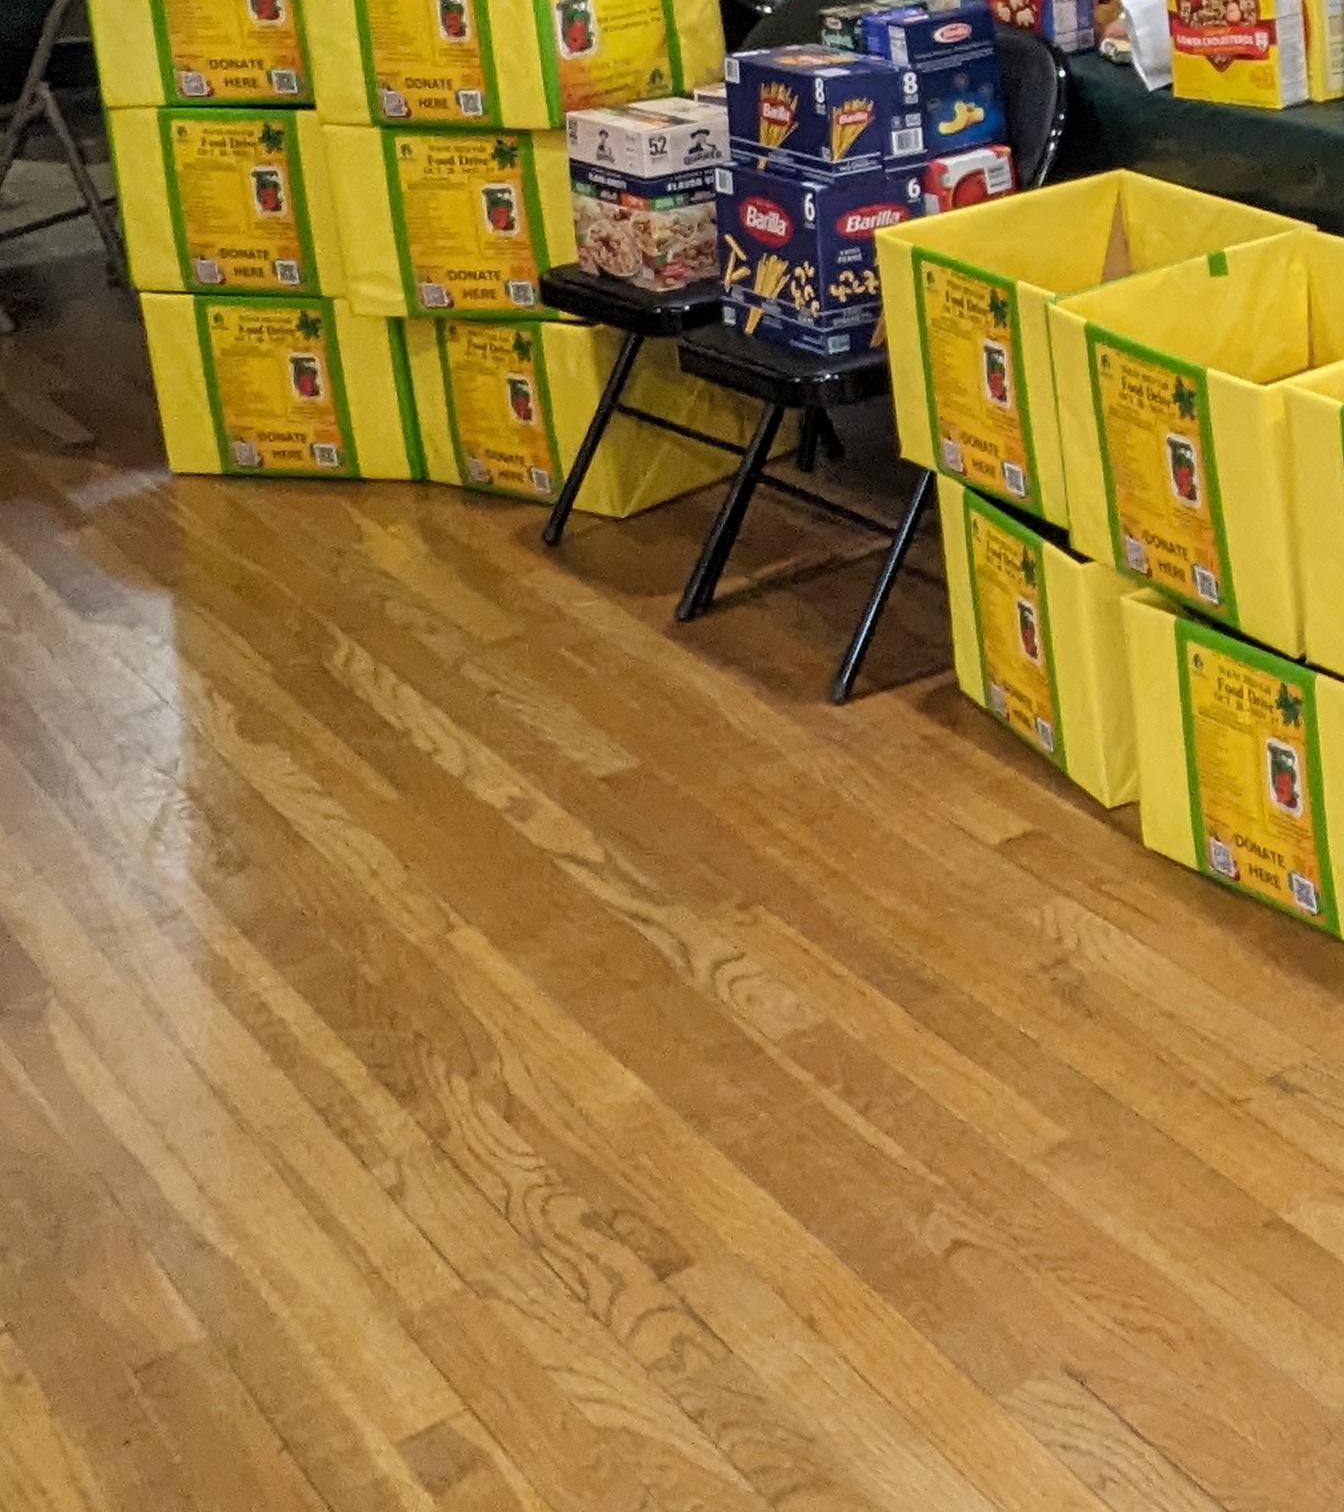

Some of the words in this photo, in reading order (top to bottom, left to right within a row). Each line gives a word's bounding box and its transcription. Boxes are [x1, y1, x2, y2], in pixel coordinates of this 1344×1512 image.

[208, 58, 265, 71] DONATE
[224, 77, 259, 89] HERE
[405, 78, 453, 90] DONATE
[814, 77, 826, 104] 8
[903, 72, 918, 94] 8
[418, 97, 448, 109] HERE
[648, 135, 668, 156] 52
[907, 177, 921, 198] 6
[804, 192, 816, 222] 6
[745, 205, 789, 238] Barilla
[845, 210, 902, 234] Barilla
[220, 248, 269, 260] DONATE
[233, 266, 264, 279] HERE
[448, 270, 502, 282] DONATE
[462, 289, 496, 301] HERE
[1142, 529, 1188, 561] DONATE
[1158, 559, 1187, 583] HERE
[1216, 677, 1245, 700] Food
[1234, 831, 1287, 871] DONATE
[1248, 859, 1282, 891] HERE
